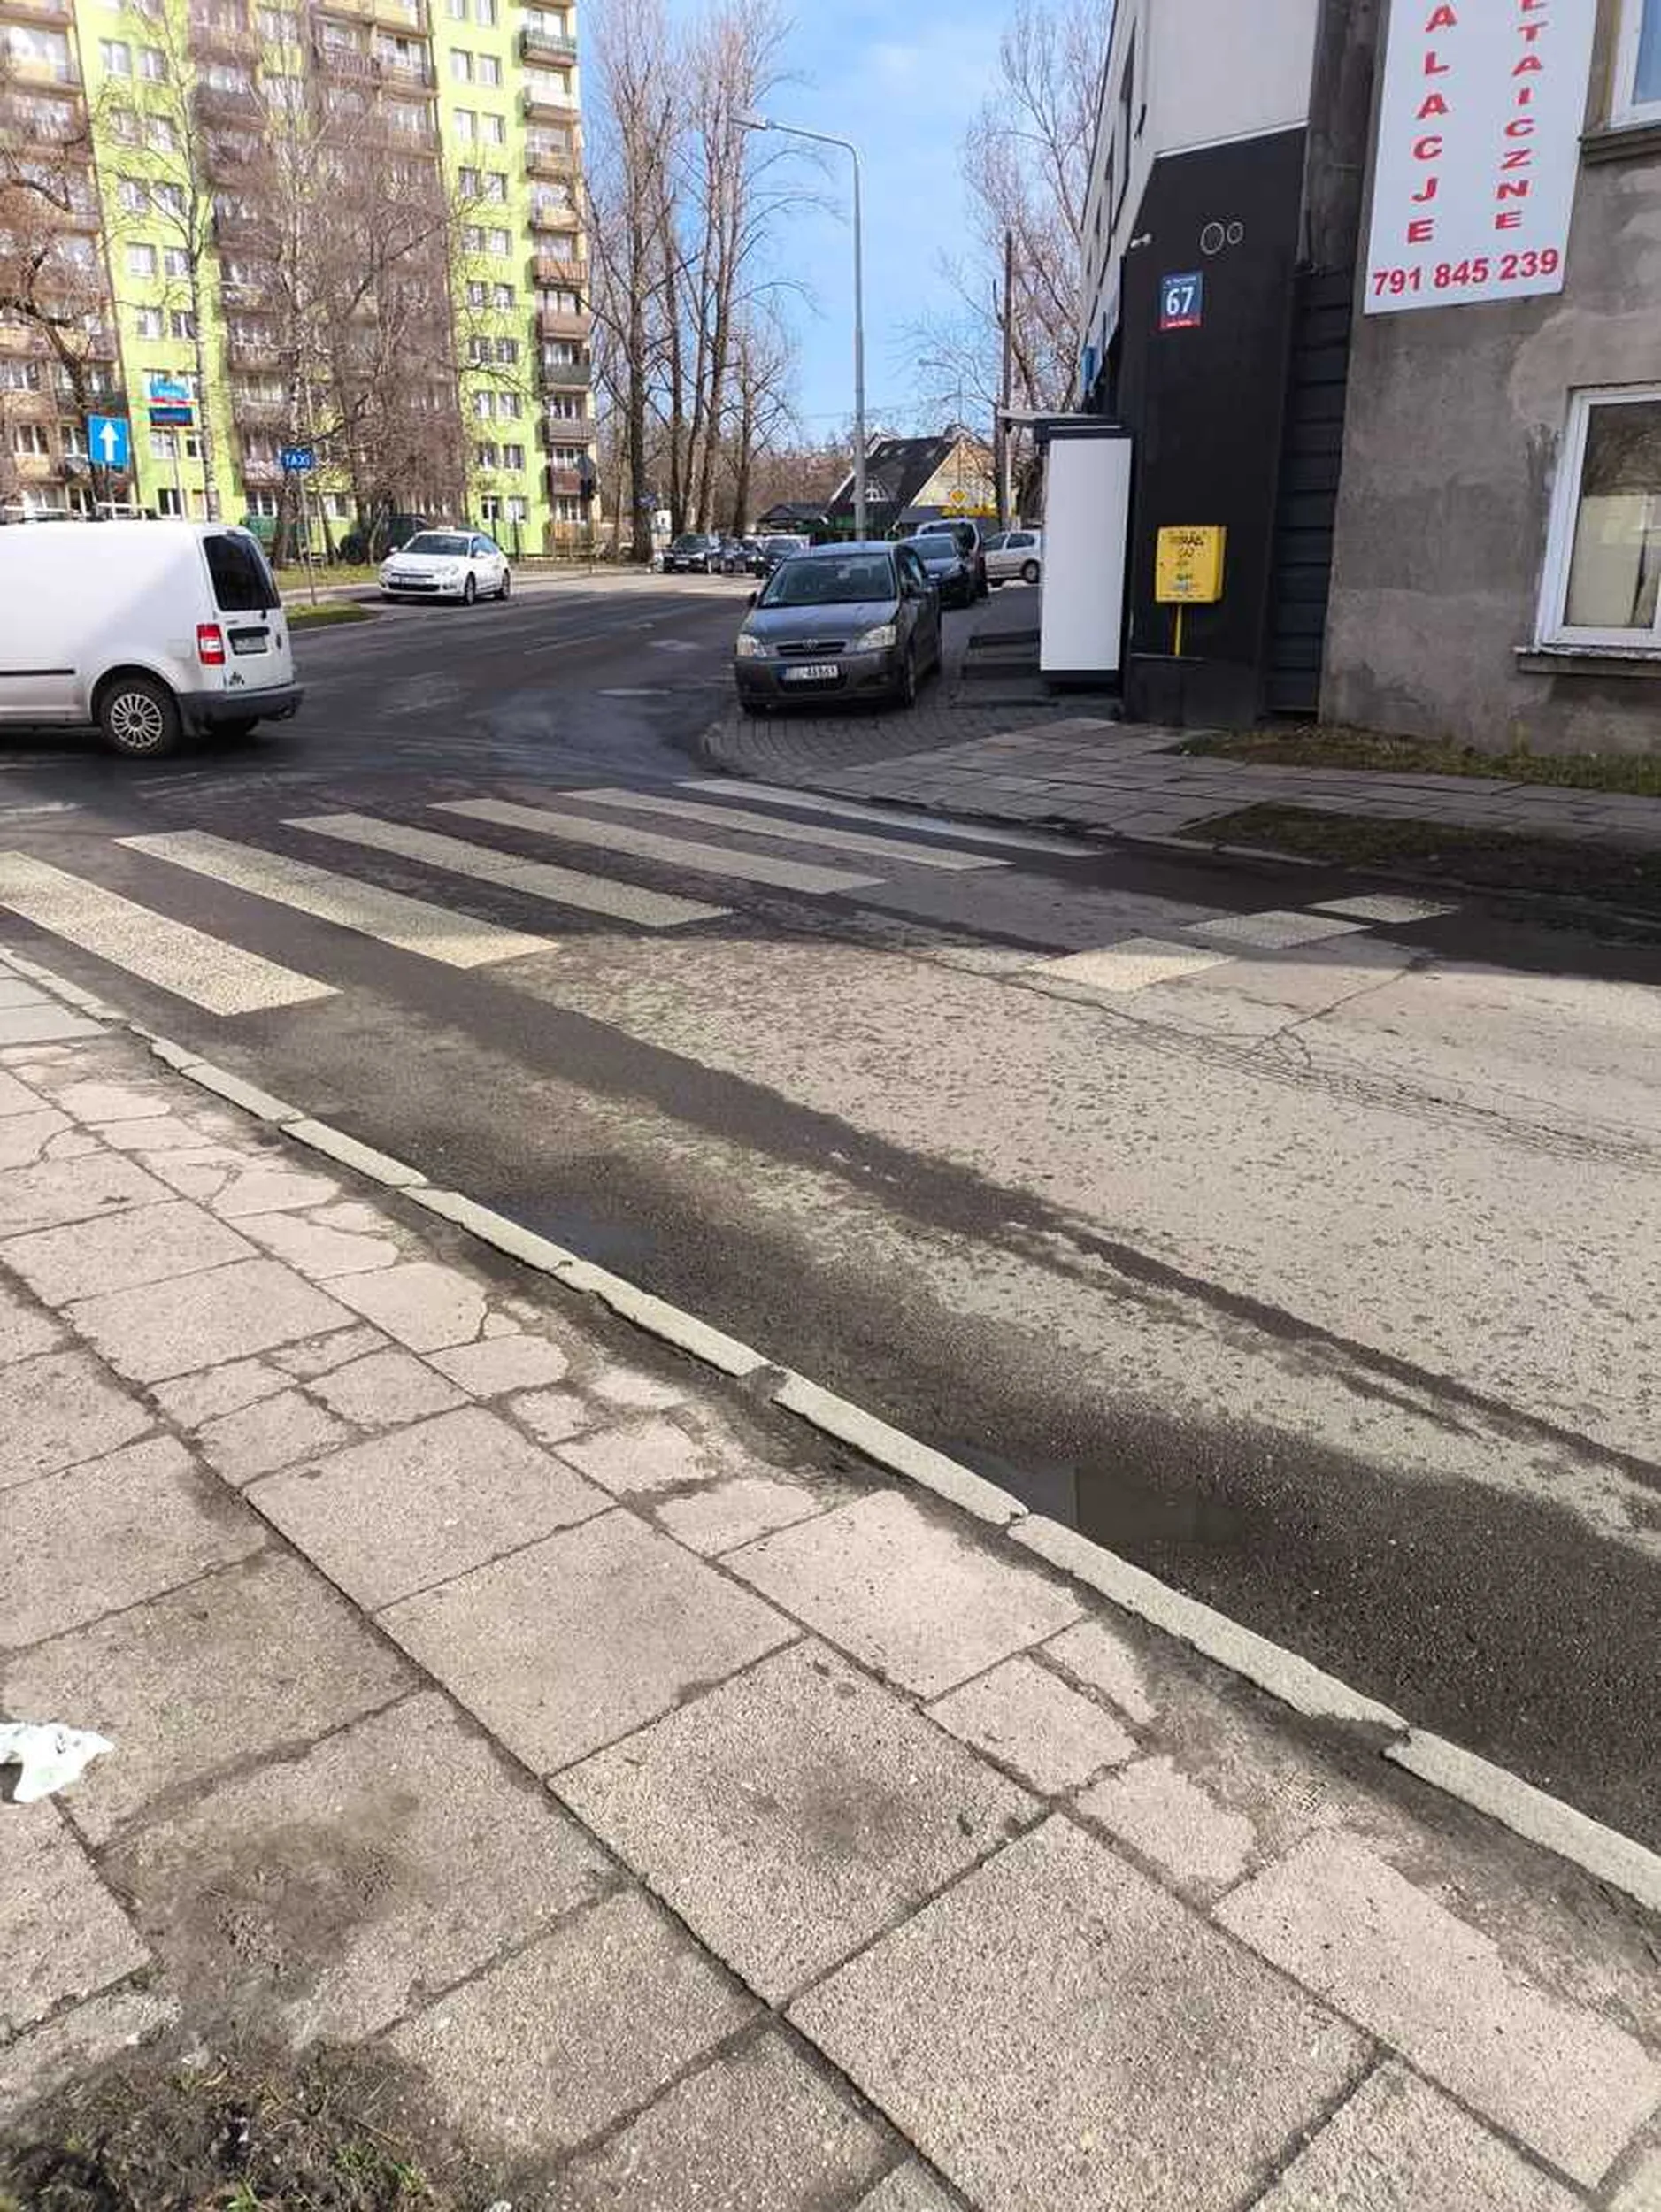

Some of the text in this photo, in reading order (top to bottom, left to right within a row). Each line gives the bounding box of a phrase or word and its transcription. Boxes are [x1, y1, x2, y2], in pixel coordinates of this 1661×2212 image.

[1373, 248, 1559, 296] 791 845 239
[1166, 286, 1195, 317] 67
[284, 453, 311, 467] TAXI
